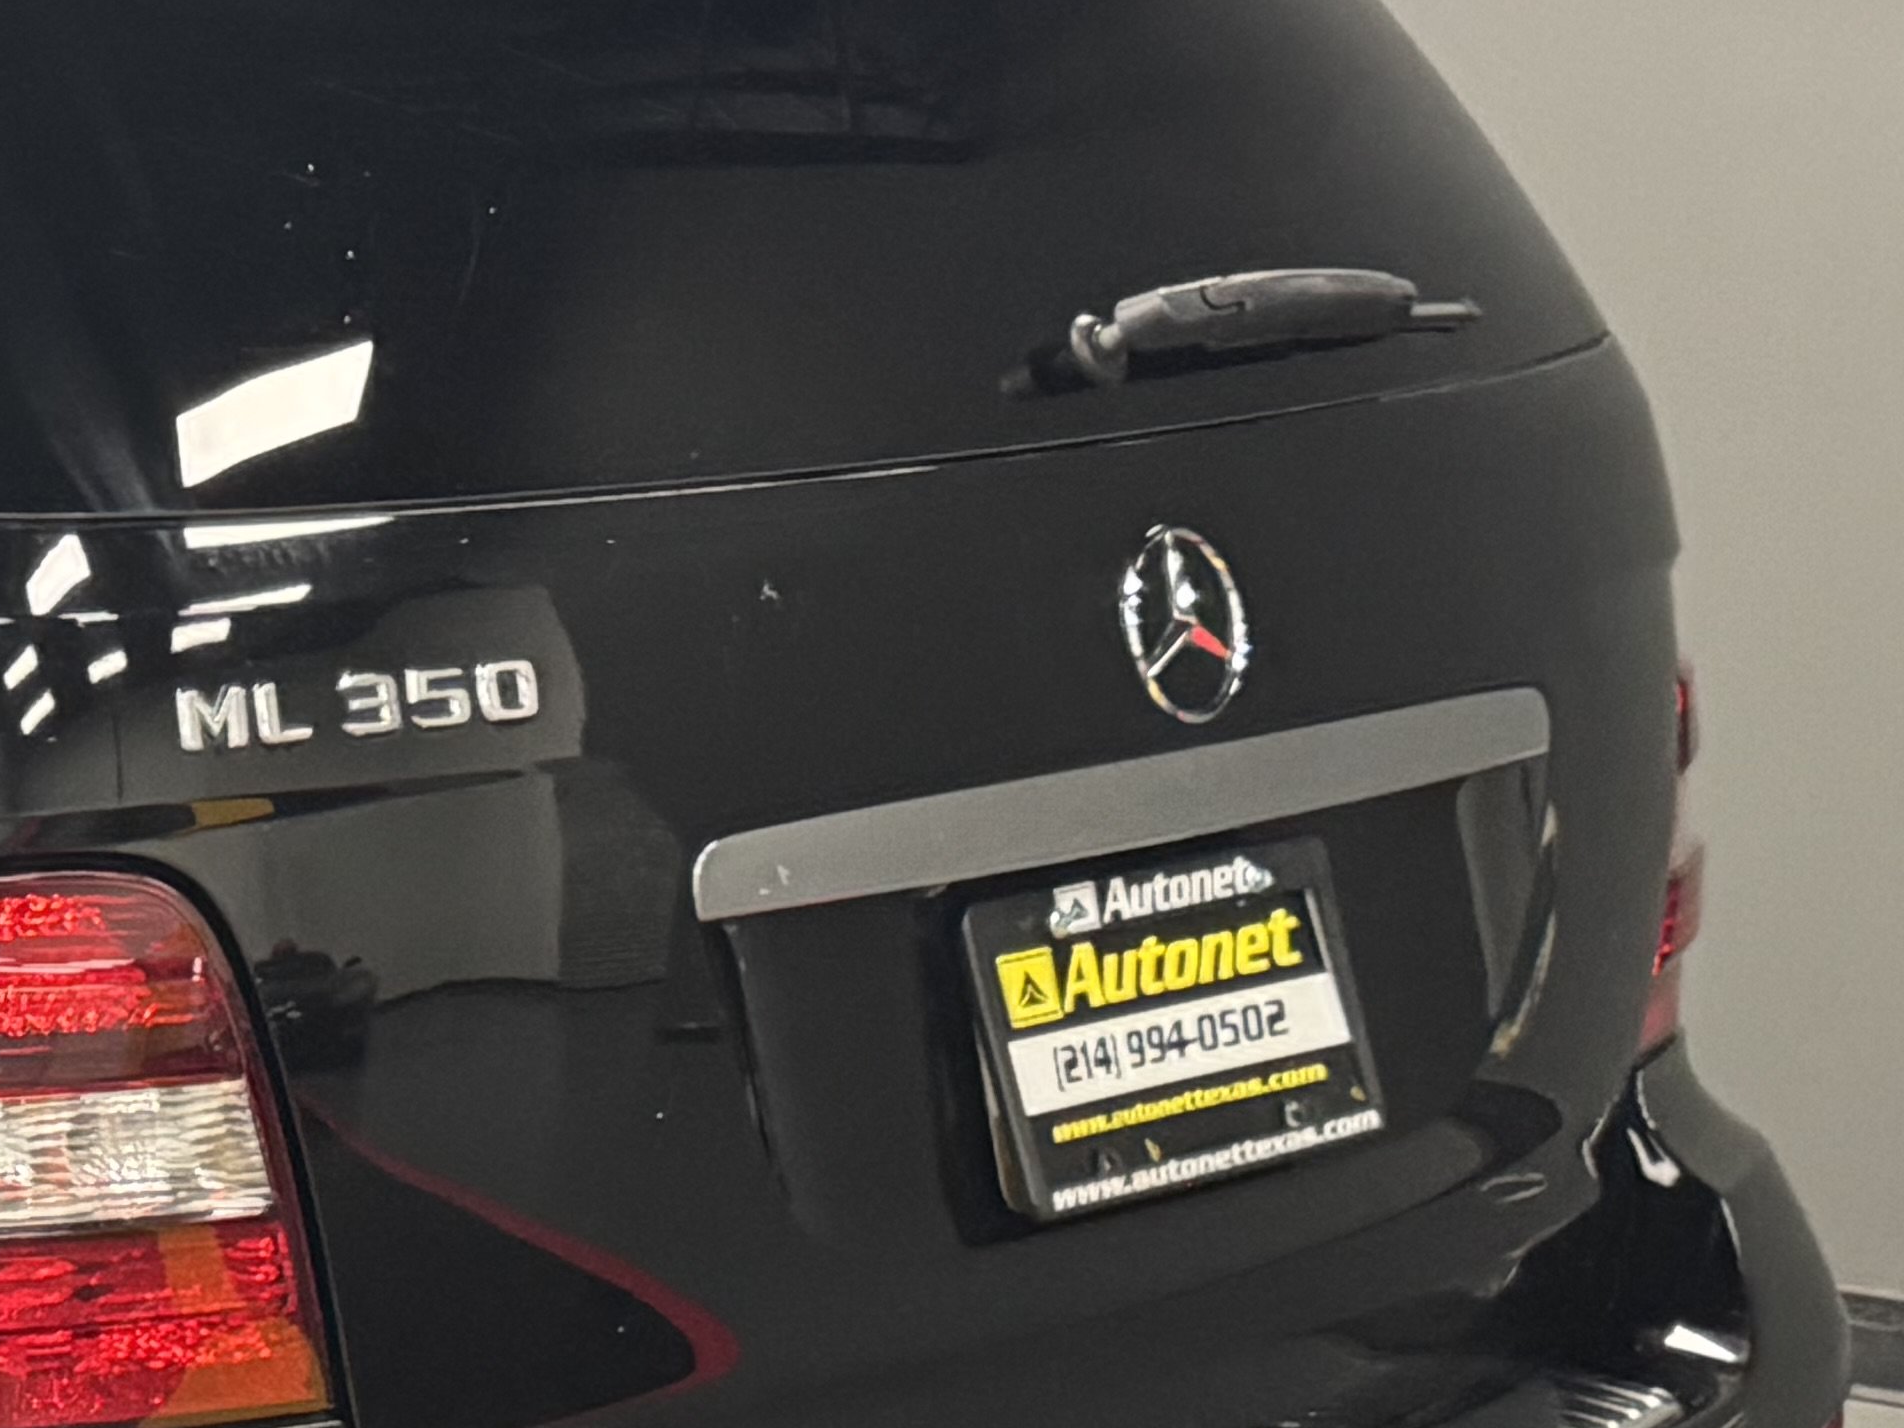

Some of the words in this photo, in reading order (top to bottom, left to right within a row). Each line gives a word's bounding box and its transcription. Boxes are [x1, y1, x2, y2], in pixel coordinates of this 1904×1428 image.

[175, 681, 314, 752] ML
[335, 659, 540, 737] 350
[1102, 855, 1256, 925] Autonet
[1063, 907, 1305, 1014] Autonet
[1052, 1032, 1122, 1092] (214)
[1127, 998, 1290, 1068] 994-0502
[1051, 1062, 1330, 1144] www.autonettexas.com
[1051, 1108, 1384, 1213] www.autonettexas.com
